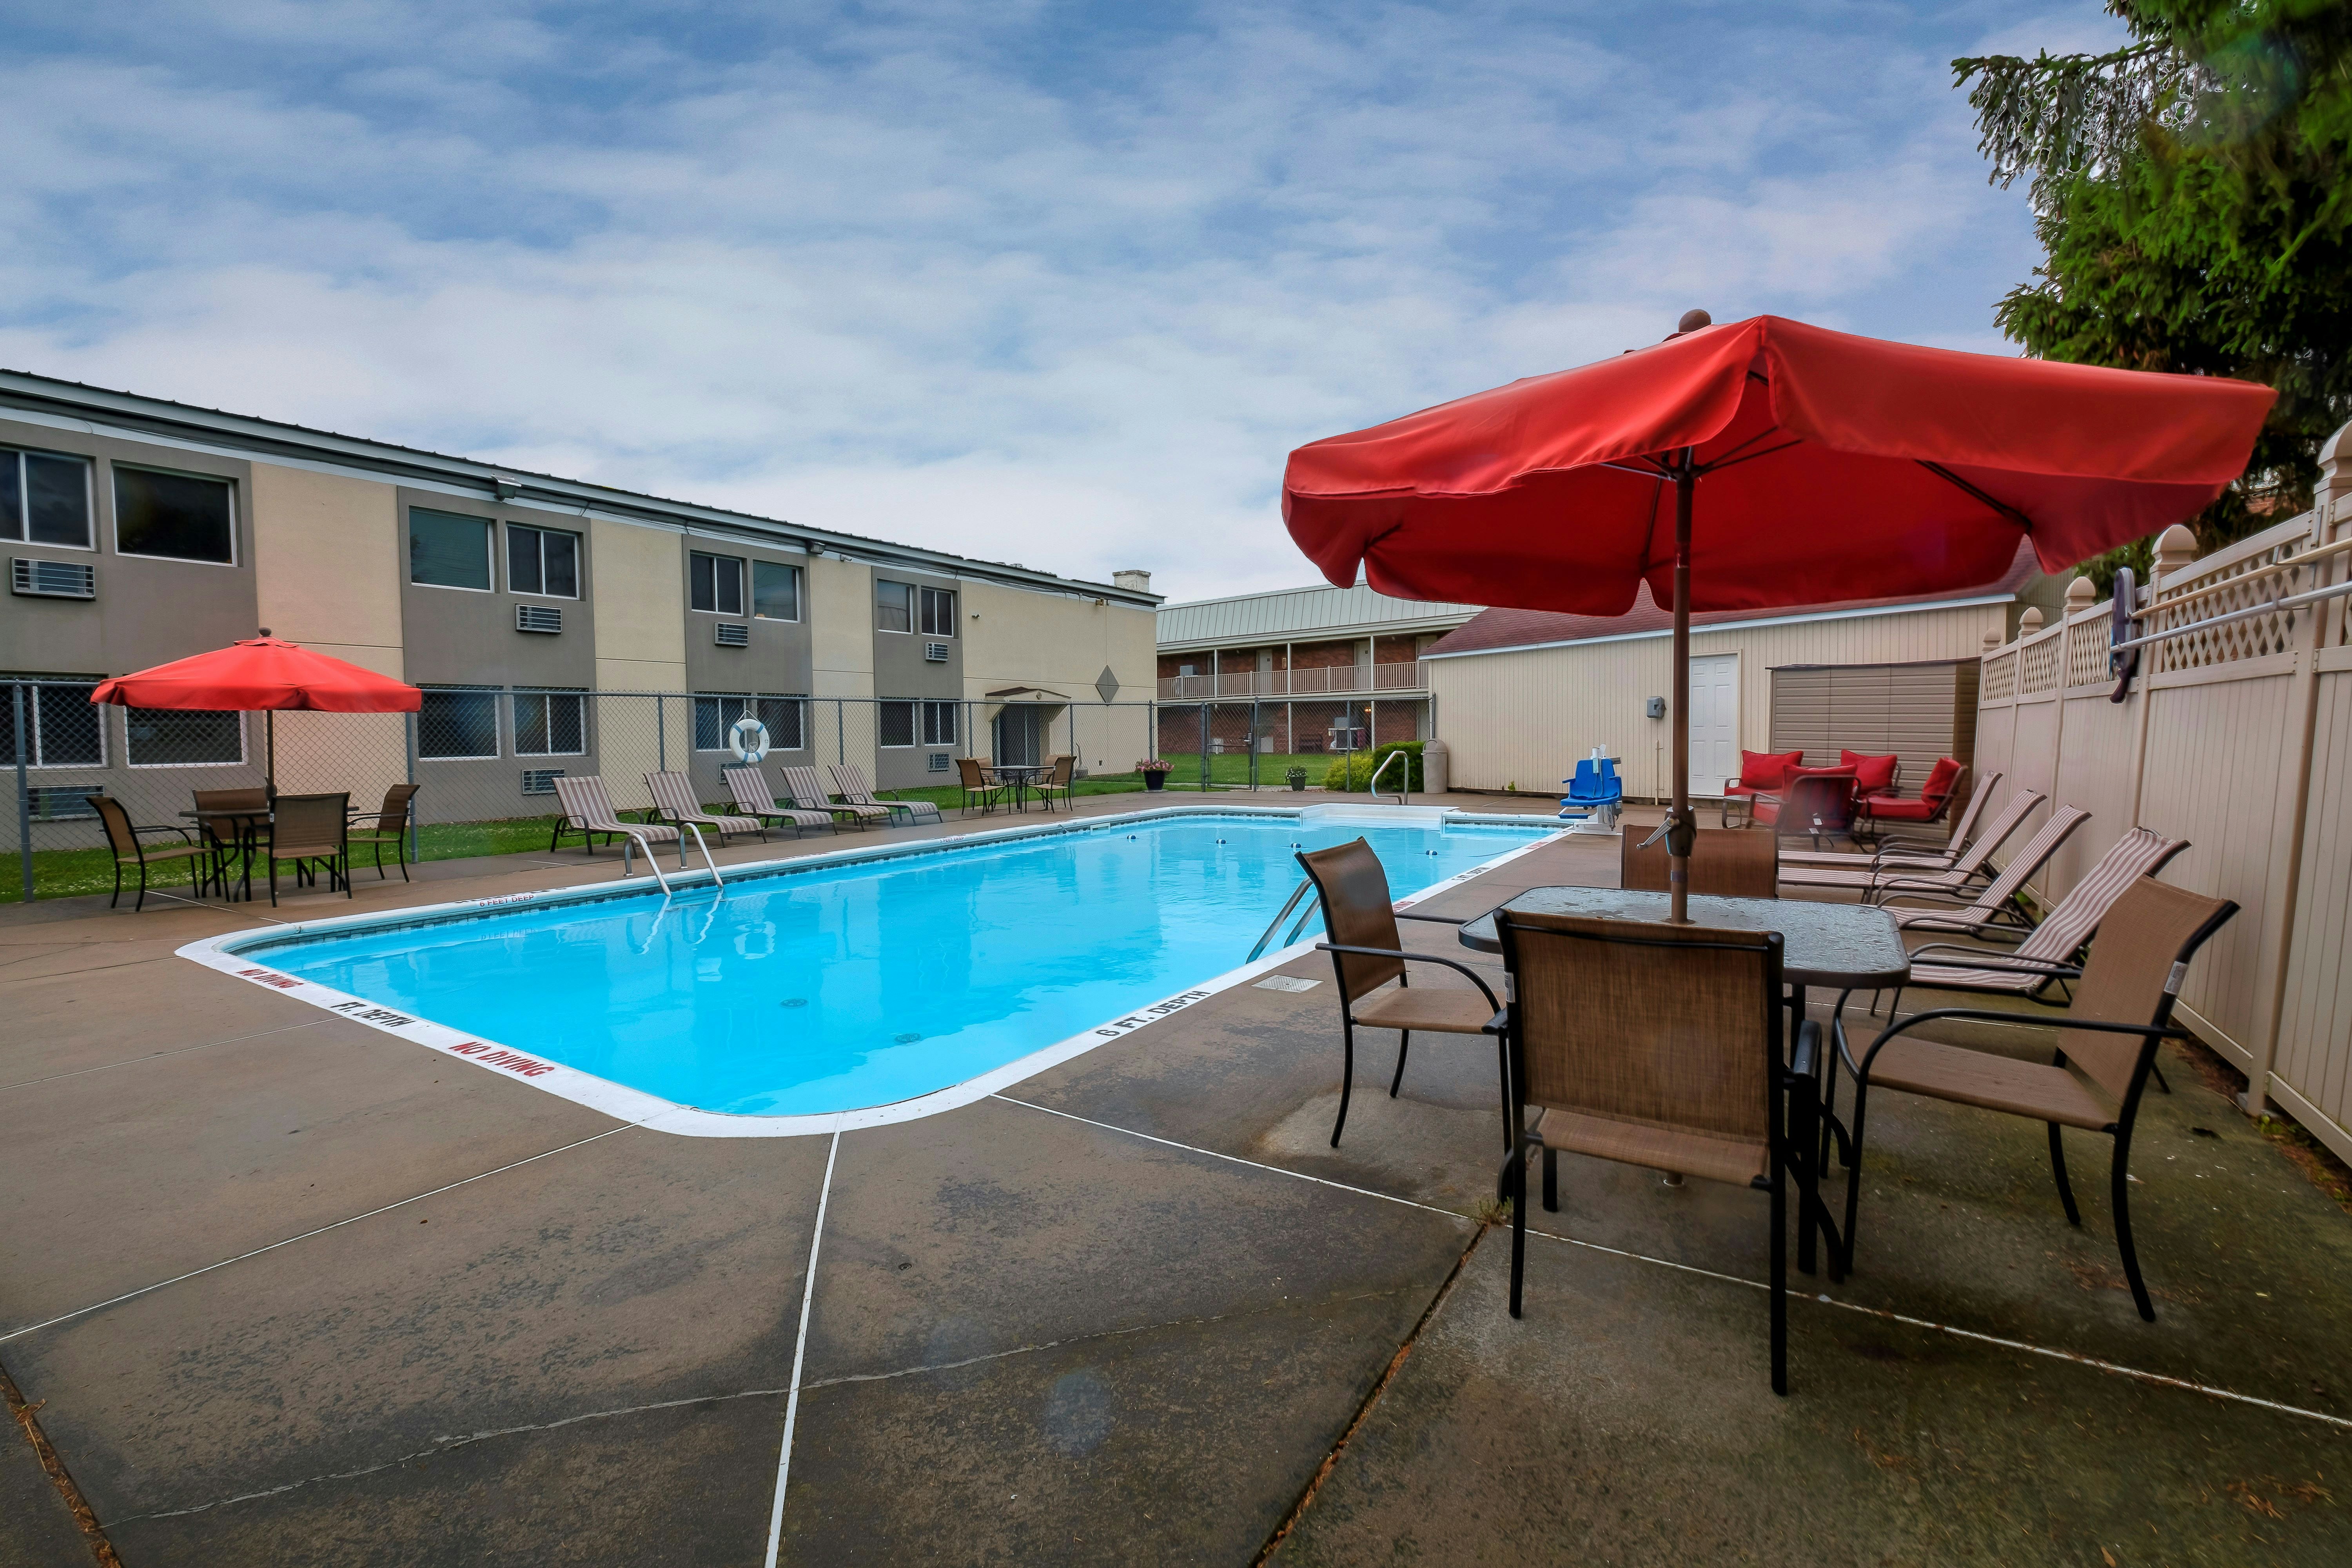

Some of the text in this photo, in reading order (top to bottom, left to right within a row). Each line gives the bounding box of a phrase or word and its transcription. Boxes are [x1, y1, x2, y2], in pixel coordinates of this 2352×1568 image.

[512, 895, 534, 903] DEEP
[1392, 901, 1416, 912] IVING
[252, 974, 304, 988] DIVING
[330, 1002, 416, 1027] FT. DEPTH
[1113, 1017, 1155, 1028] FT.
[1146, 991, 1211, 1014] DEPTH
[448, 1042, 555, 1077] NO DIVING
